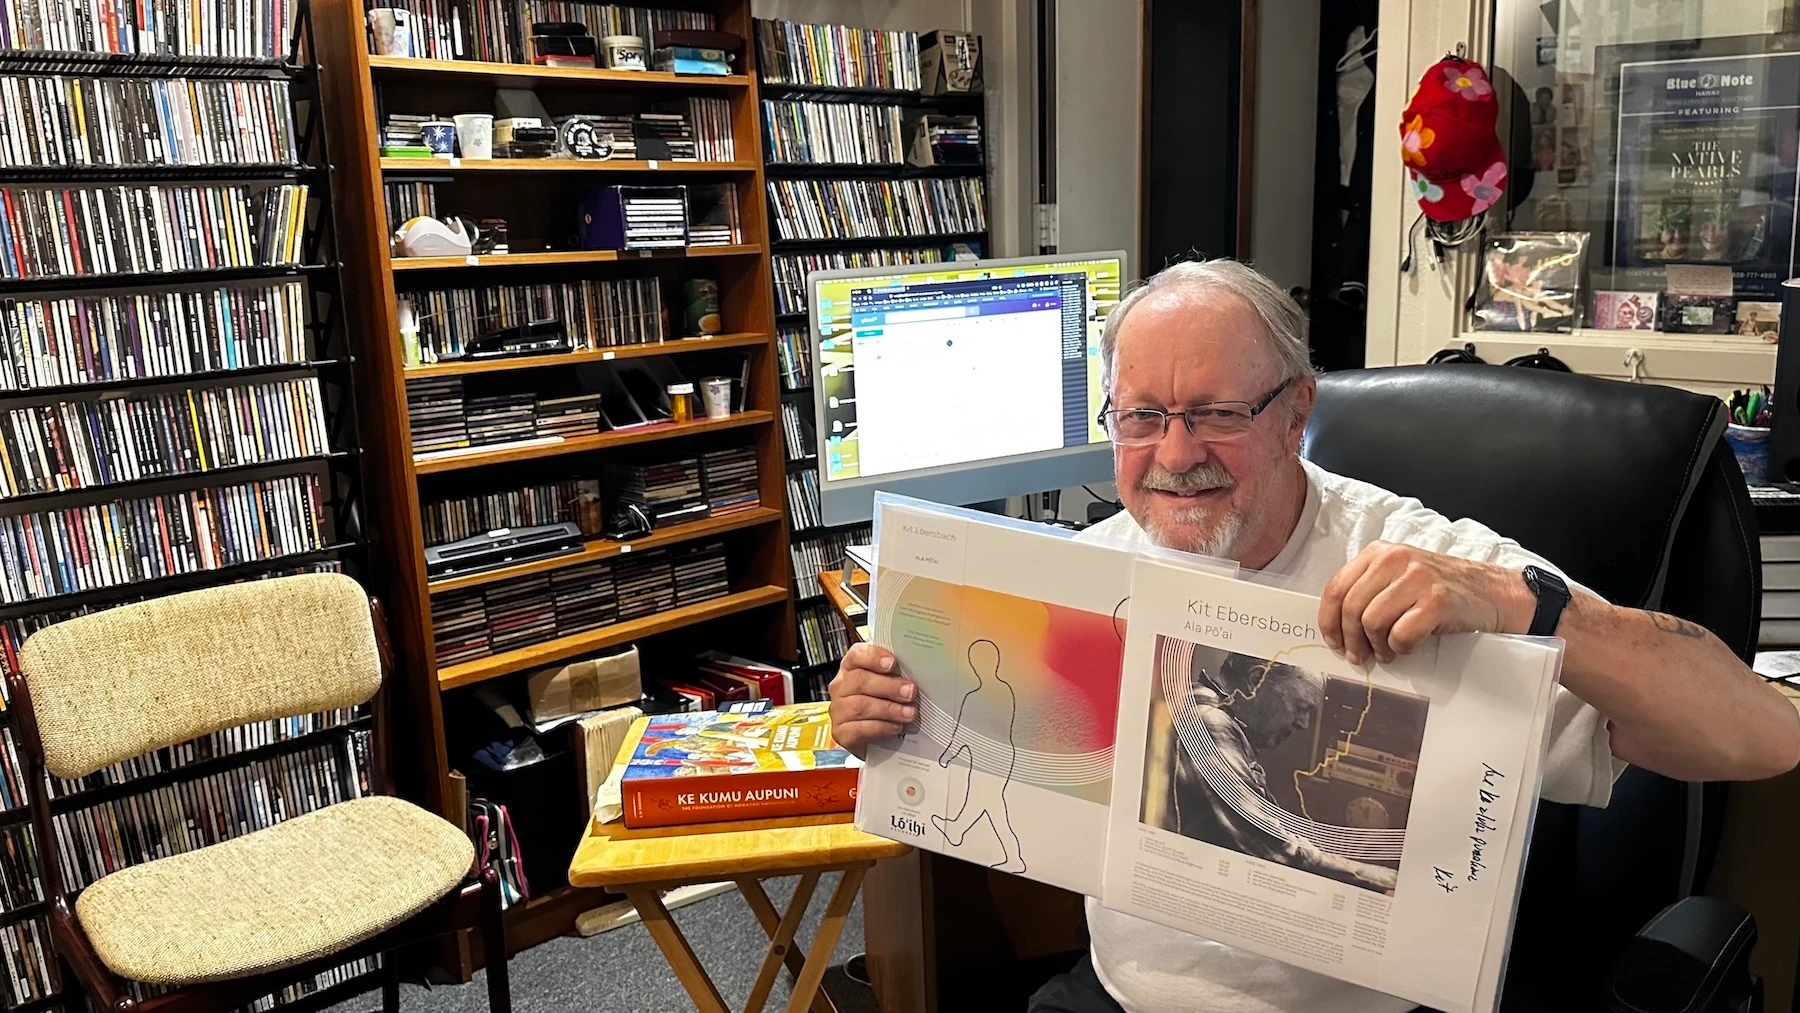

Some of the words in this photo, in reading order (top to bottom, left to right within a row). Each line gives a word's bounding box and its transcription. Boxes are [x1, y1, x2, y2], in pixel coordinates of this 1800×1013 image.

[1666, 78, 1697, 90] Blue
[1720, 74, 1754, 87] Note
[1695, 89, 1720, 97] HAWAII
[1678, 106, 1740, 116] FEATURING
[1692, 140, 1720, 151] THE
[1671, 149, 1742, 165] NATIVE
[1670, 164, 1741, 179] PEARLS
[903, 525, 913, 533] Kit
[915, 526, 957, 541] Ebersbach
[1187, 598, 1212, 618] Kit
[1216, 605, 1317, 640] Ebersbach
[1184, 621, 1202, 633] Ala
[677, 793, 696, 806] KE
[699, 790, 742, 804] KUMU
[744, 787, 799, 802] AUPUNI
